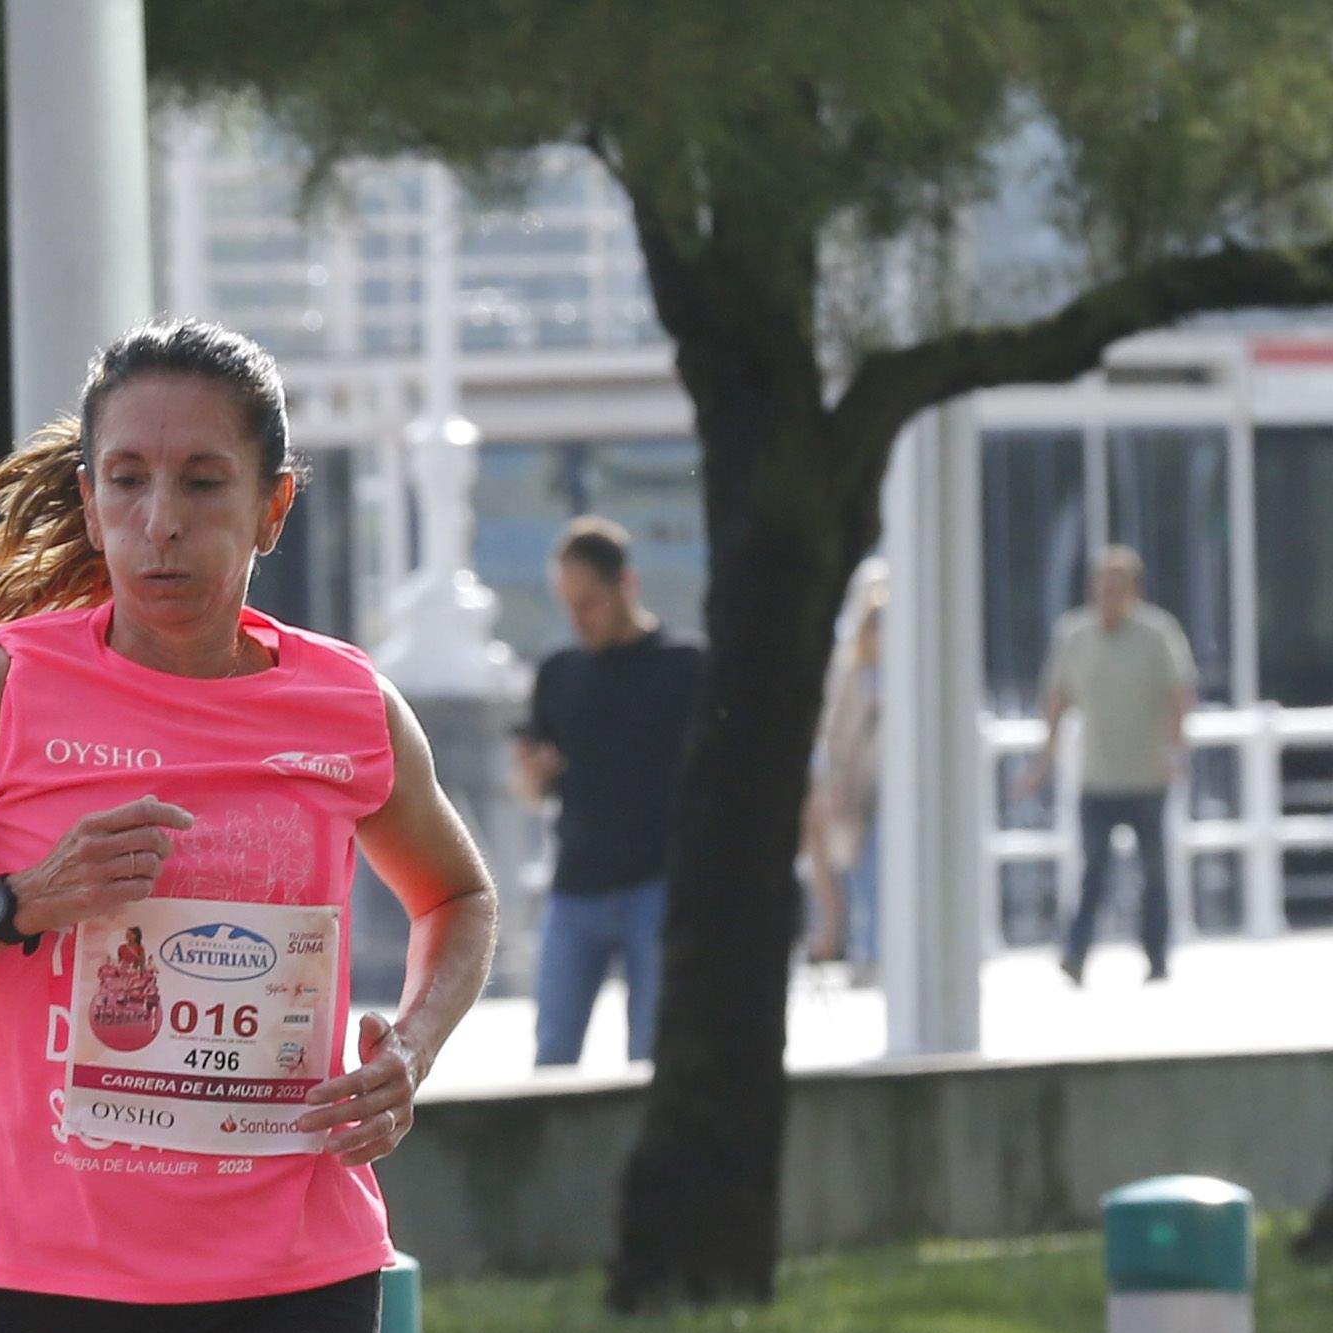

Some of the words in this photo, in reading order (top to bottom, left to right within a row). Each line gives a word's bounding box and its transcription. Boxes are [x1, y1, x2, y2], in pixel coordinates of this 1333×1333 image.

[44, 738, 163, 769] OYSHO
[170, 942, 268, 968] ASTURIANA
[287, 940, 324, 954] SUMA
[170, 1000, 259, 1038] 016
[183, 1048, 240, 1071] 4796
[100, 1073, 176, 1092] CARRERA
[180, 1080, 202, 1095] DE
[206, 1082, 225, 1096] LA
[228, 1084, 273, 1098] MUJER
[276, 1085, 305, 1098] 2023
[91, 1101, 175, 1129] OYSHO
[103, 1158, 123, 1173] DE
[125, 1159, 144, 1174] LA
[147, 1160, 199, 1175] MUJER
[217, 1159, 253, 1174] 2023
